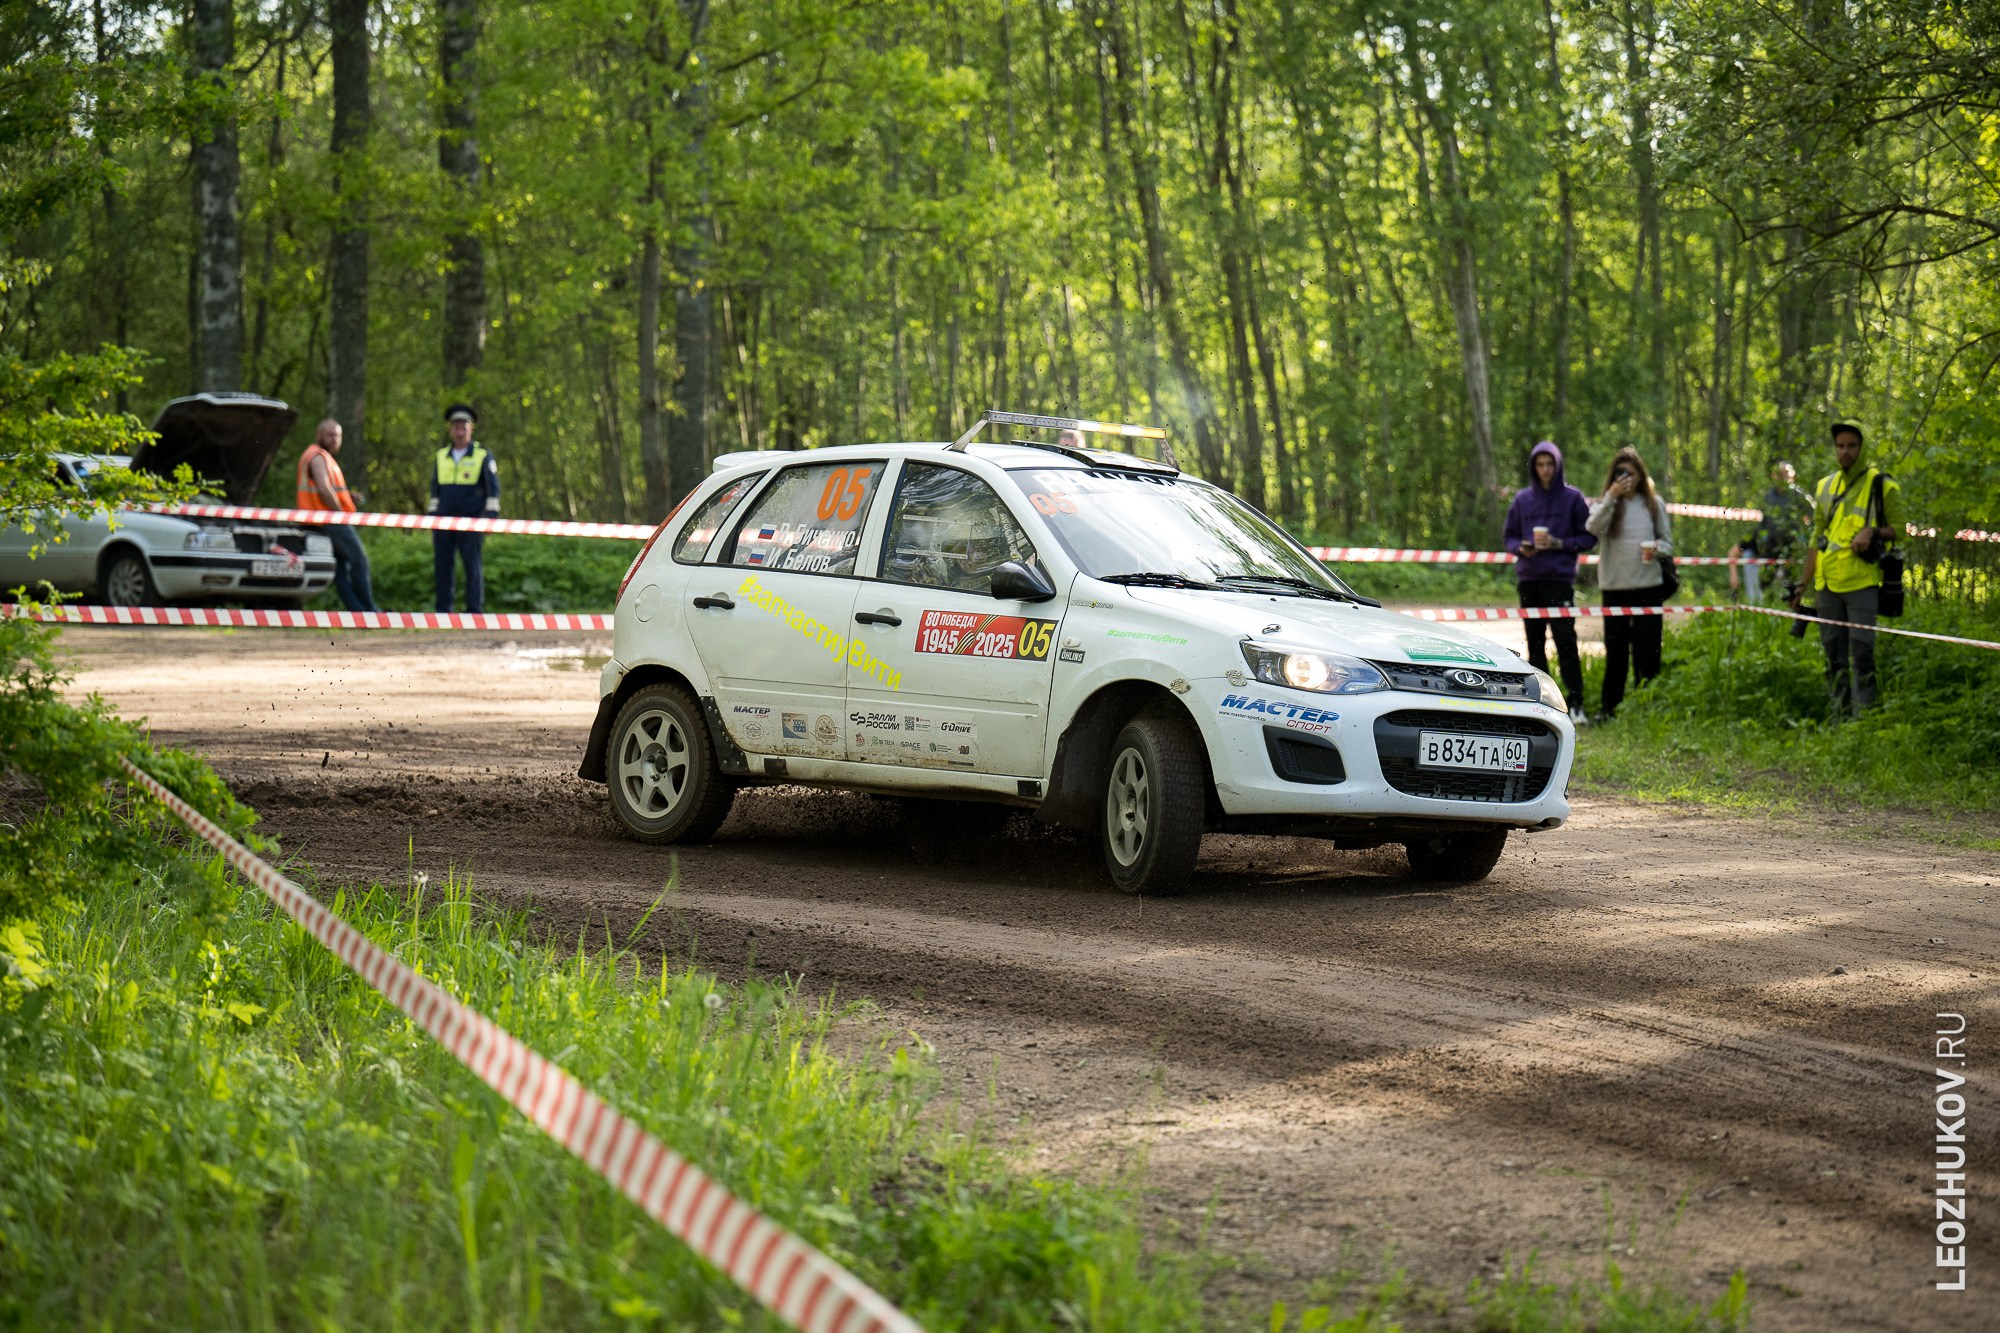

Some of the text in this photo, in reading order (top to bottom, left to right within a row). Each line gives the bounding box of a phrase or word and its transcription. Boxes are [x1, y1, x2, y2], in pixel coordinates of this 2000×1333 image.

[817, 468, 872, 521] 05
[1029, 492, 1077, 515] 05
[925, 612, 978, 628] 80 ПОБЕДА!
[737, 573, 902, 692] #запчастиуВити
[1018, 621, 1056, 658] 05
[1107, 628, 1188, 645] #запчастиуВити
[922, 628, 1016, 658] 1945 2025
[1455, 646, 1491, 663] 05
[733, 705, 771, 715] МАСТЕР
[1219, 710, 1266, 722] www.master-sport.ru
[1221, 694, 1340, 723] МАСТЕР
[866, 721, 900, 731] РОССИИ
[1286, 720, 1332, 734] СПОРТ
[1505, 742, 1522, 760] 60
